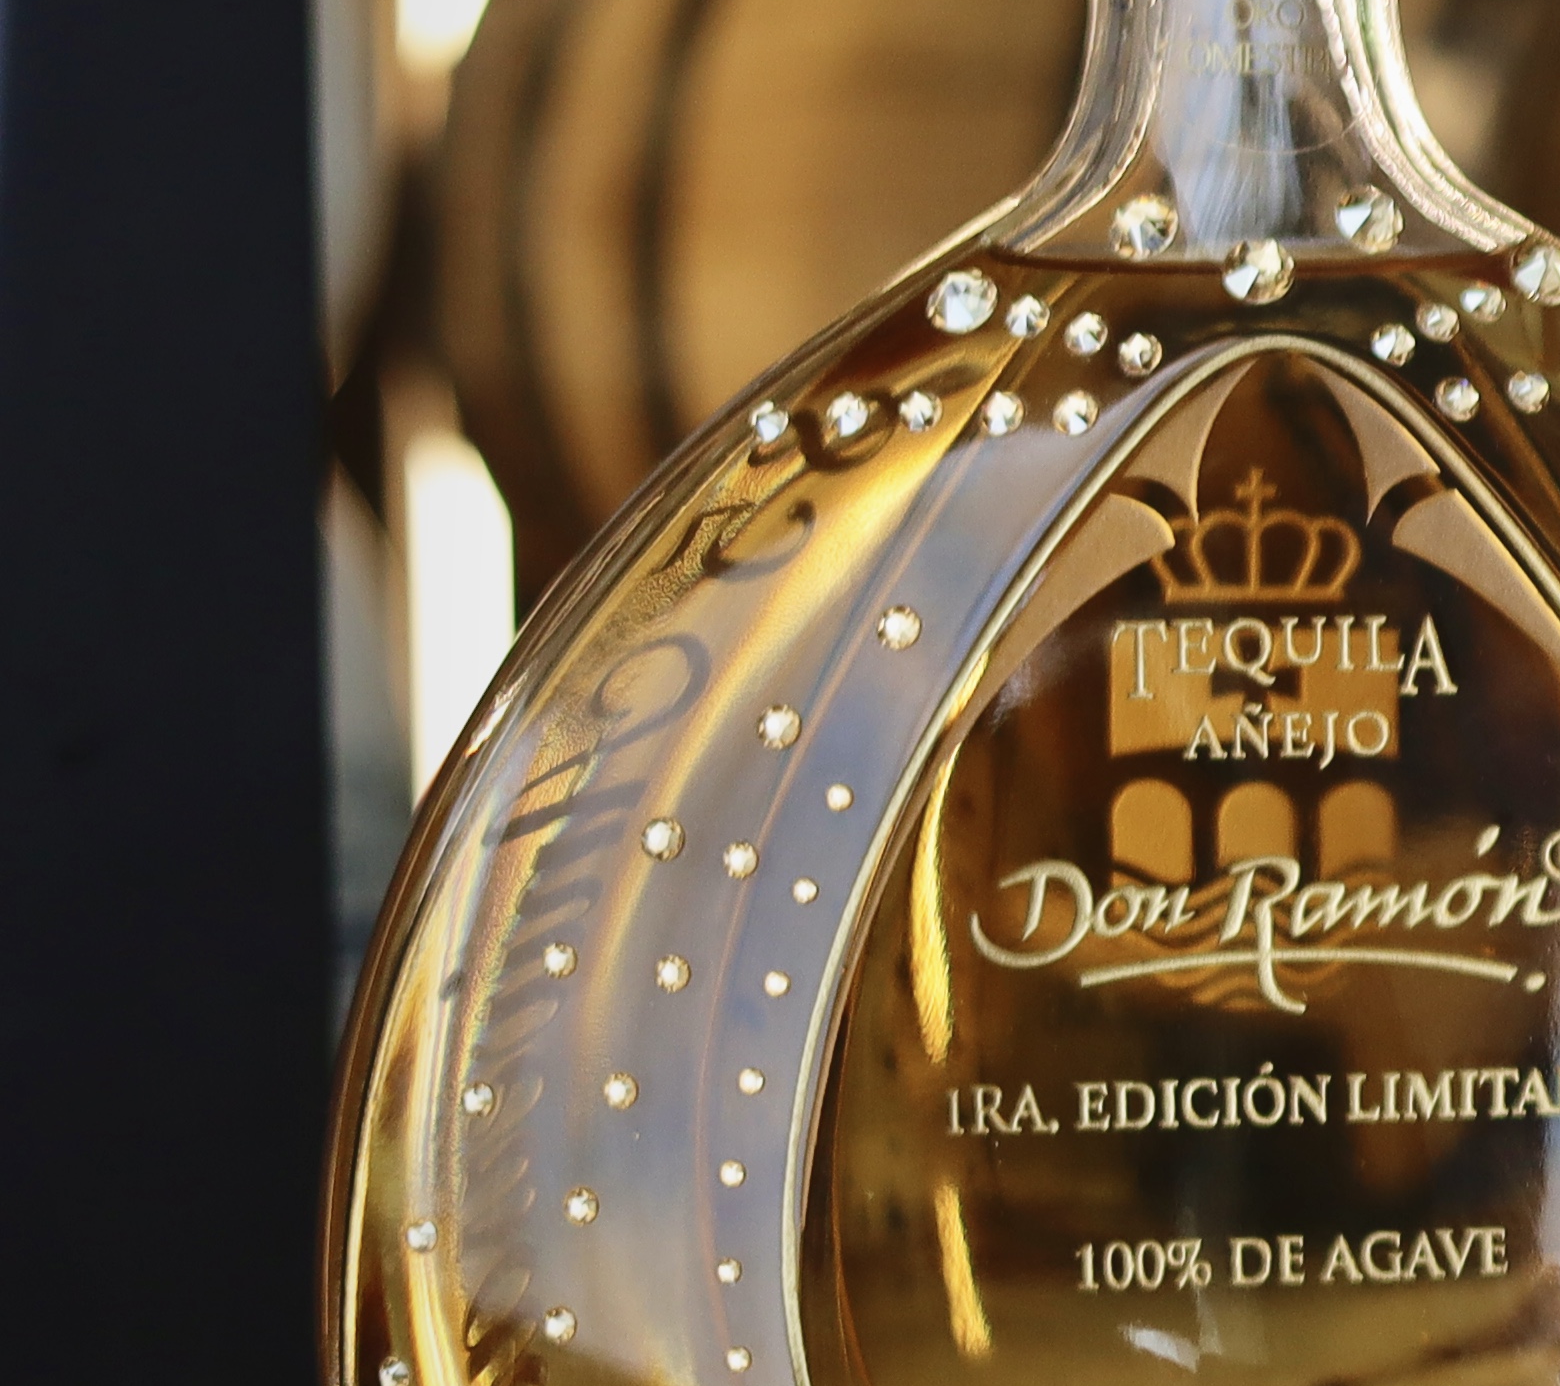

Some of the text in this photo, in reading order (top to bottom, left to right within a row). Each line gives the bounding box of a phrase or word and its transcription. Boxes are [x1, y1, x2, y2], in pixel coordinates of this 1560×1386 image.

[1111, 614, 1458, 699] TEQUILA
[1183, 702, 1390, 769] AÑEJO
[970, 860, 1192, 968] Don
[946, 1085, 1060, 1136] 1RA.
[1077, 1064, 1332, 1132] EDICIÓN
[1073, 1228, 1509, 1293] 100% DE AGAVE
